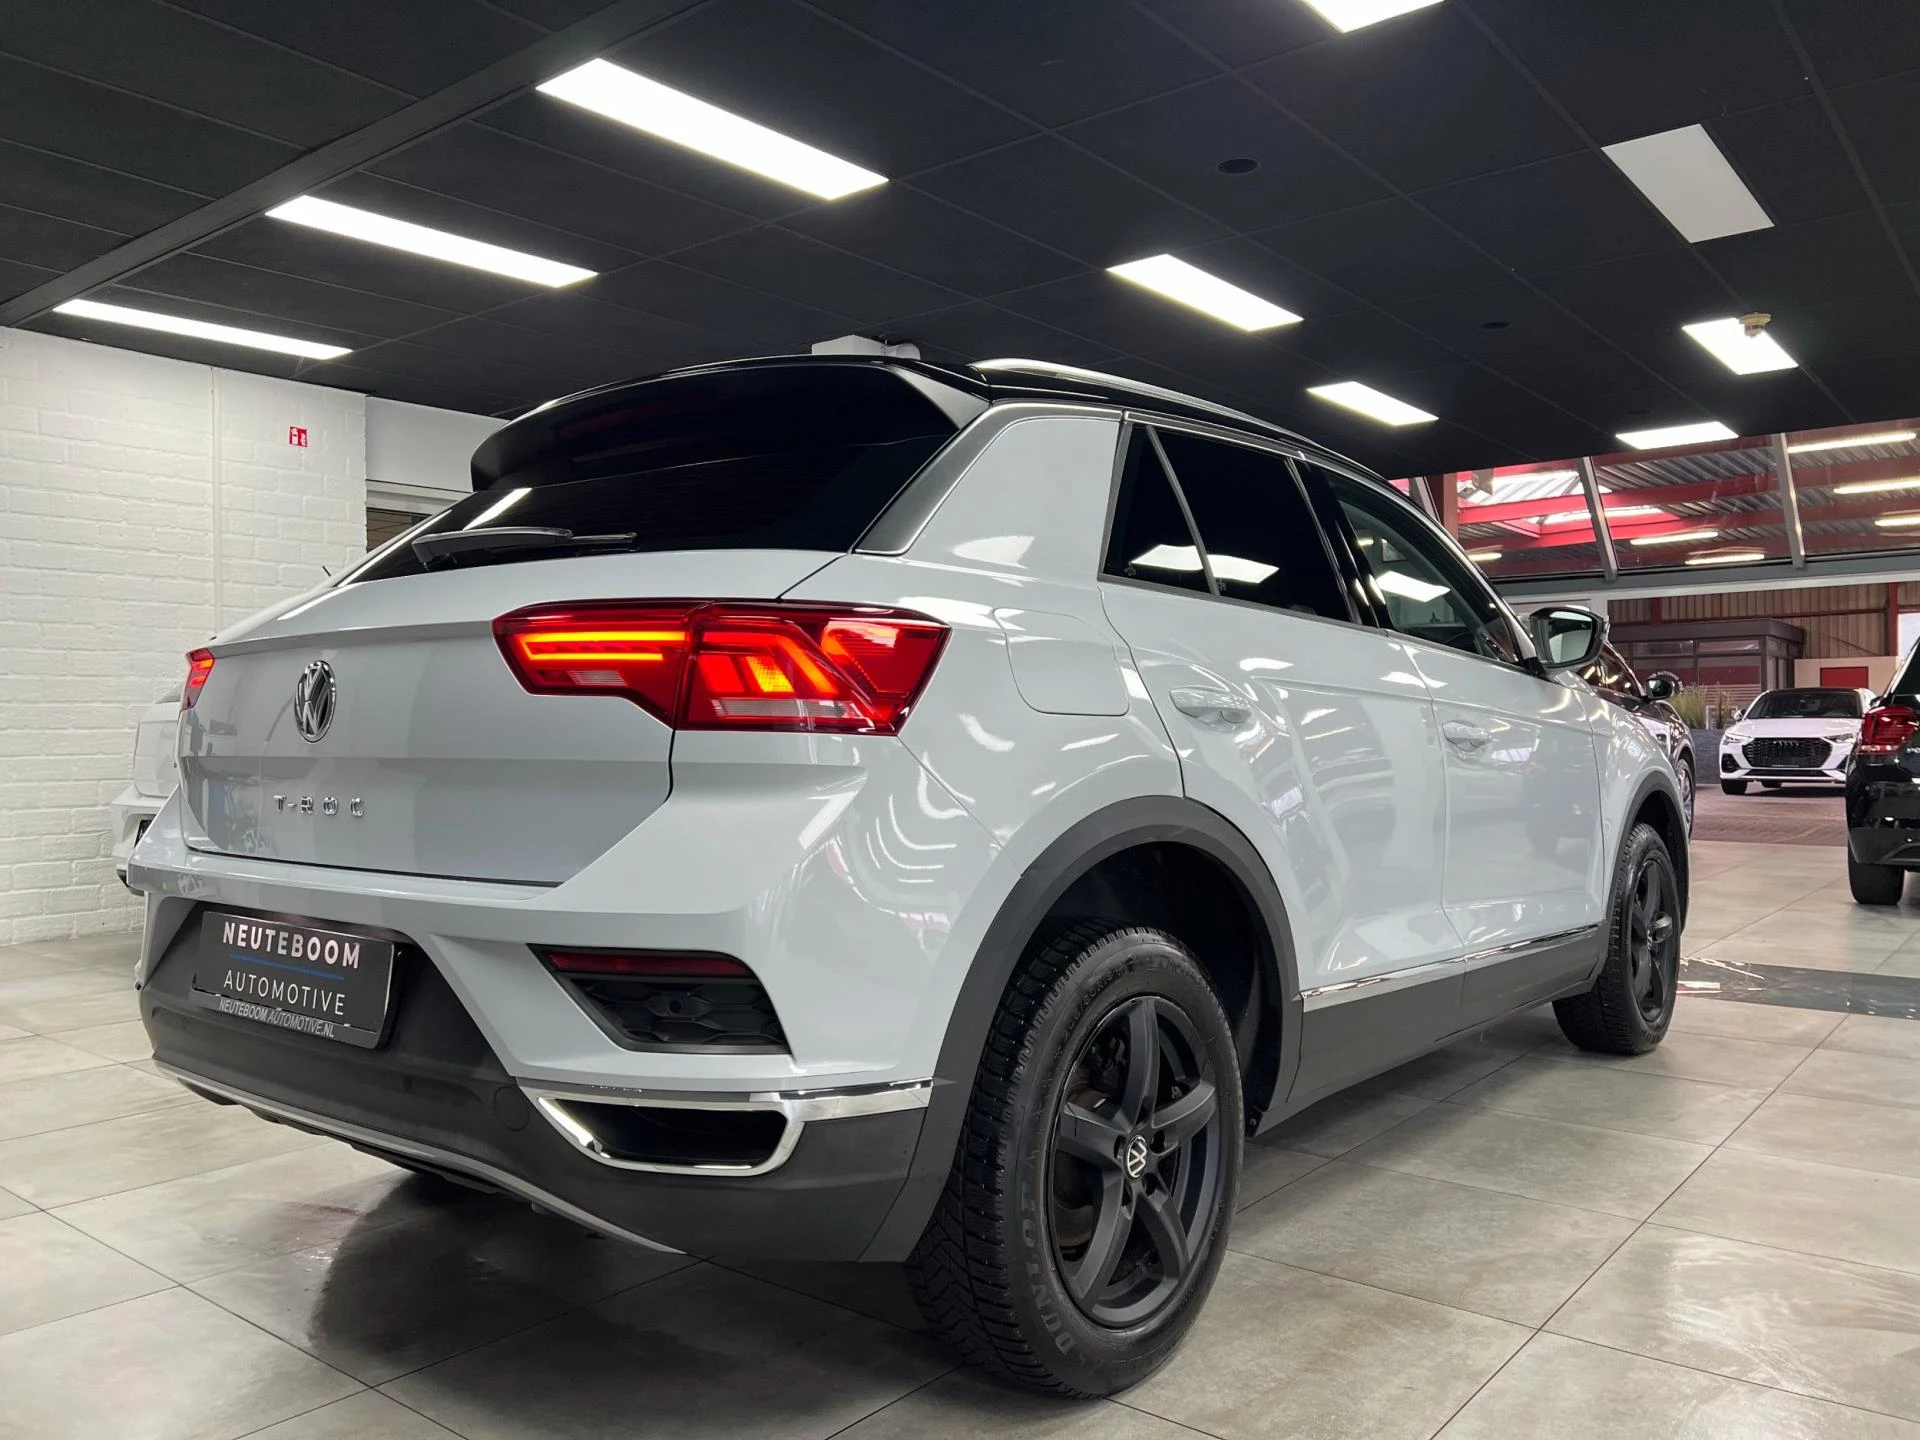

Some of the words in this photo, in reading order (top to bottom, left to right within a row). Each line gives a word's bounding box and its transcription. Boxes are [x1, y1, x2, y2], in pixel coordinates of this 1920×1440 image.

[273, 794, 364, 817] T-ROC
[222, 921, 360, 969] NEUTEBOOM
[223, 969, 346, 1016] AUTOMOTIVE
